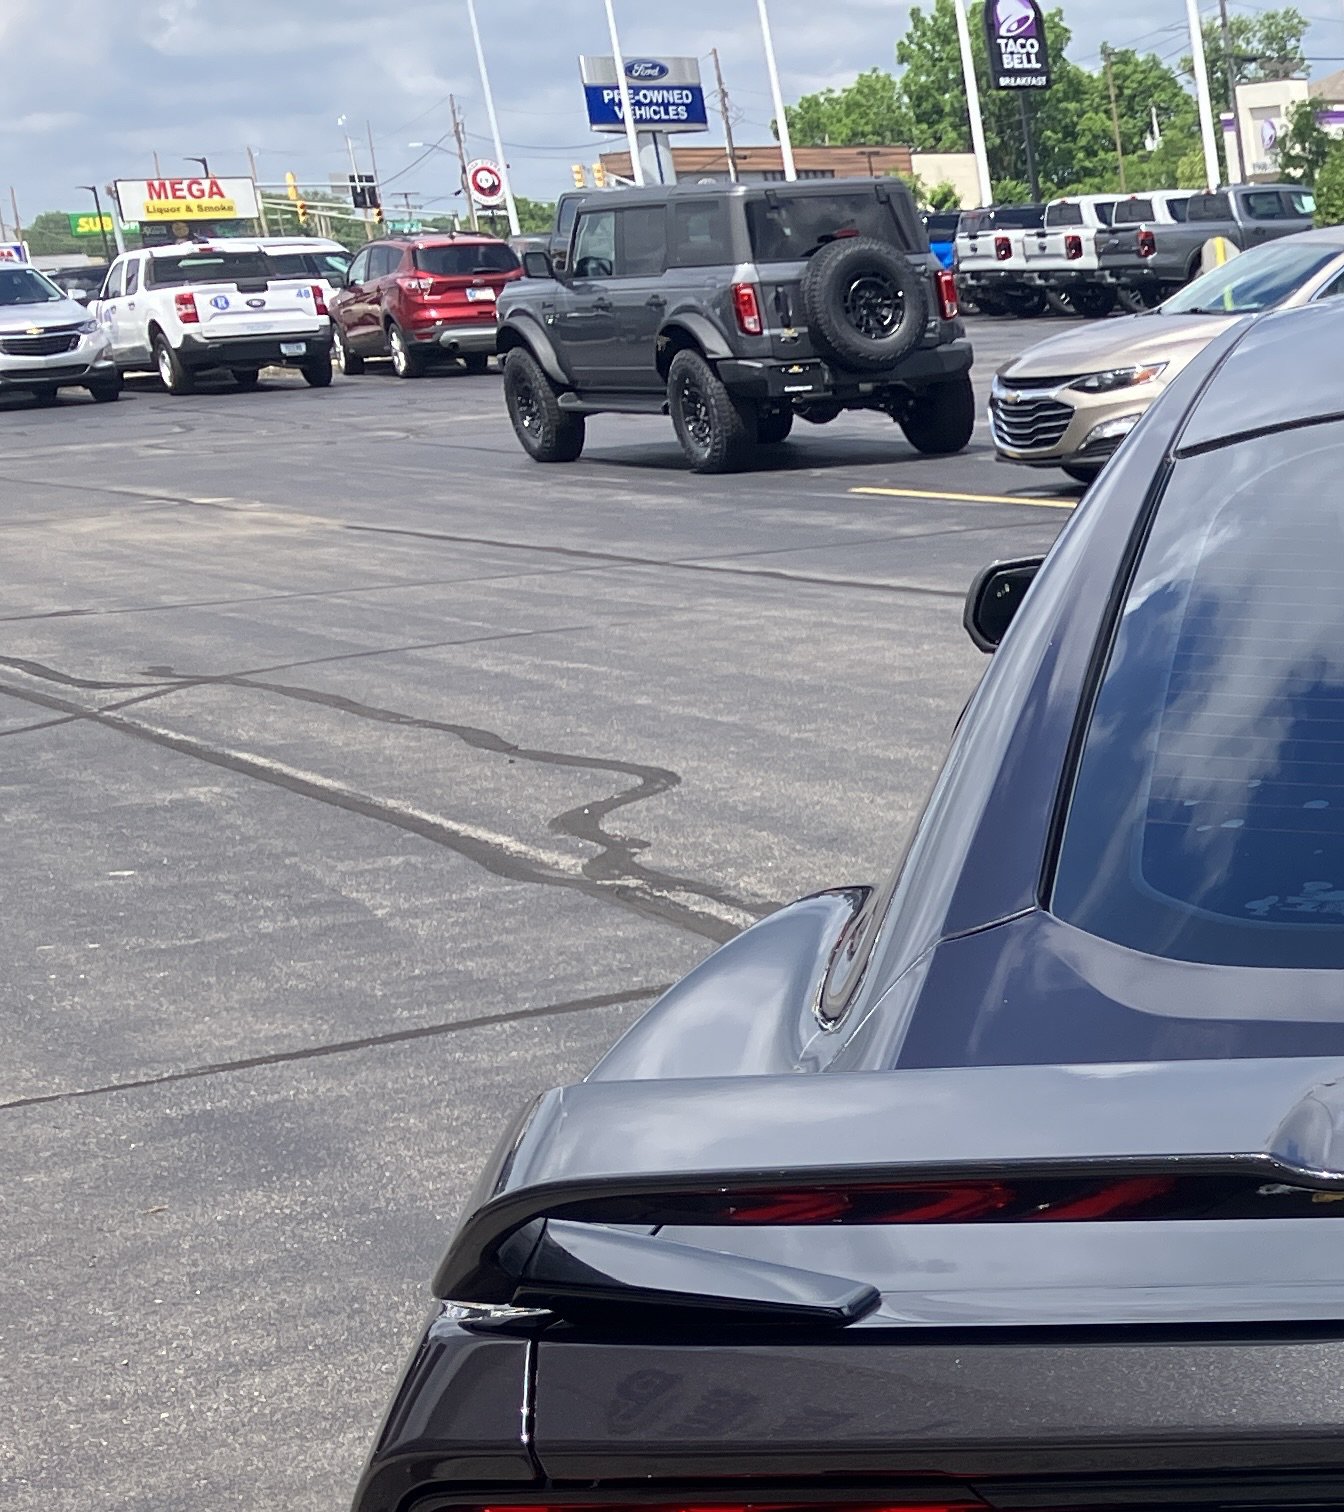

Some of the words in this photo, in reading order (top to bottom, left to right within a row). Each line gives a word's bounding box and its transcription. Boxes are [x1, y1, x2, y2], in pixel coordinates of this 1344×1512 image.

[996, 38, 1039, 53] TACO
[1002, 53, 1042, 69] BELL
[632, 63, 660, 77] Ford
[146, 178, 225, 200] MEGA
[146, 205, 181, 215] Liquor
[185, 204, 193, 213] &
[197, 203, 234, 213] Smoke
